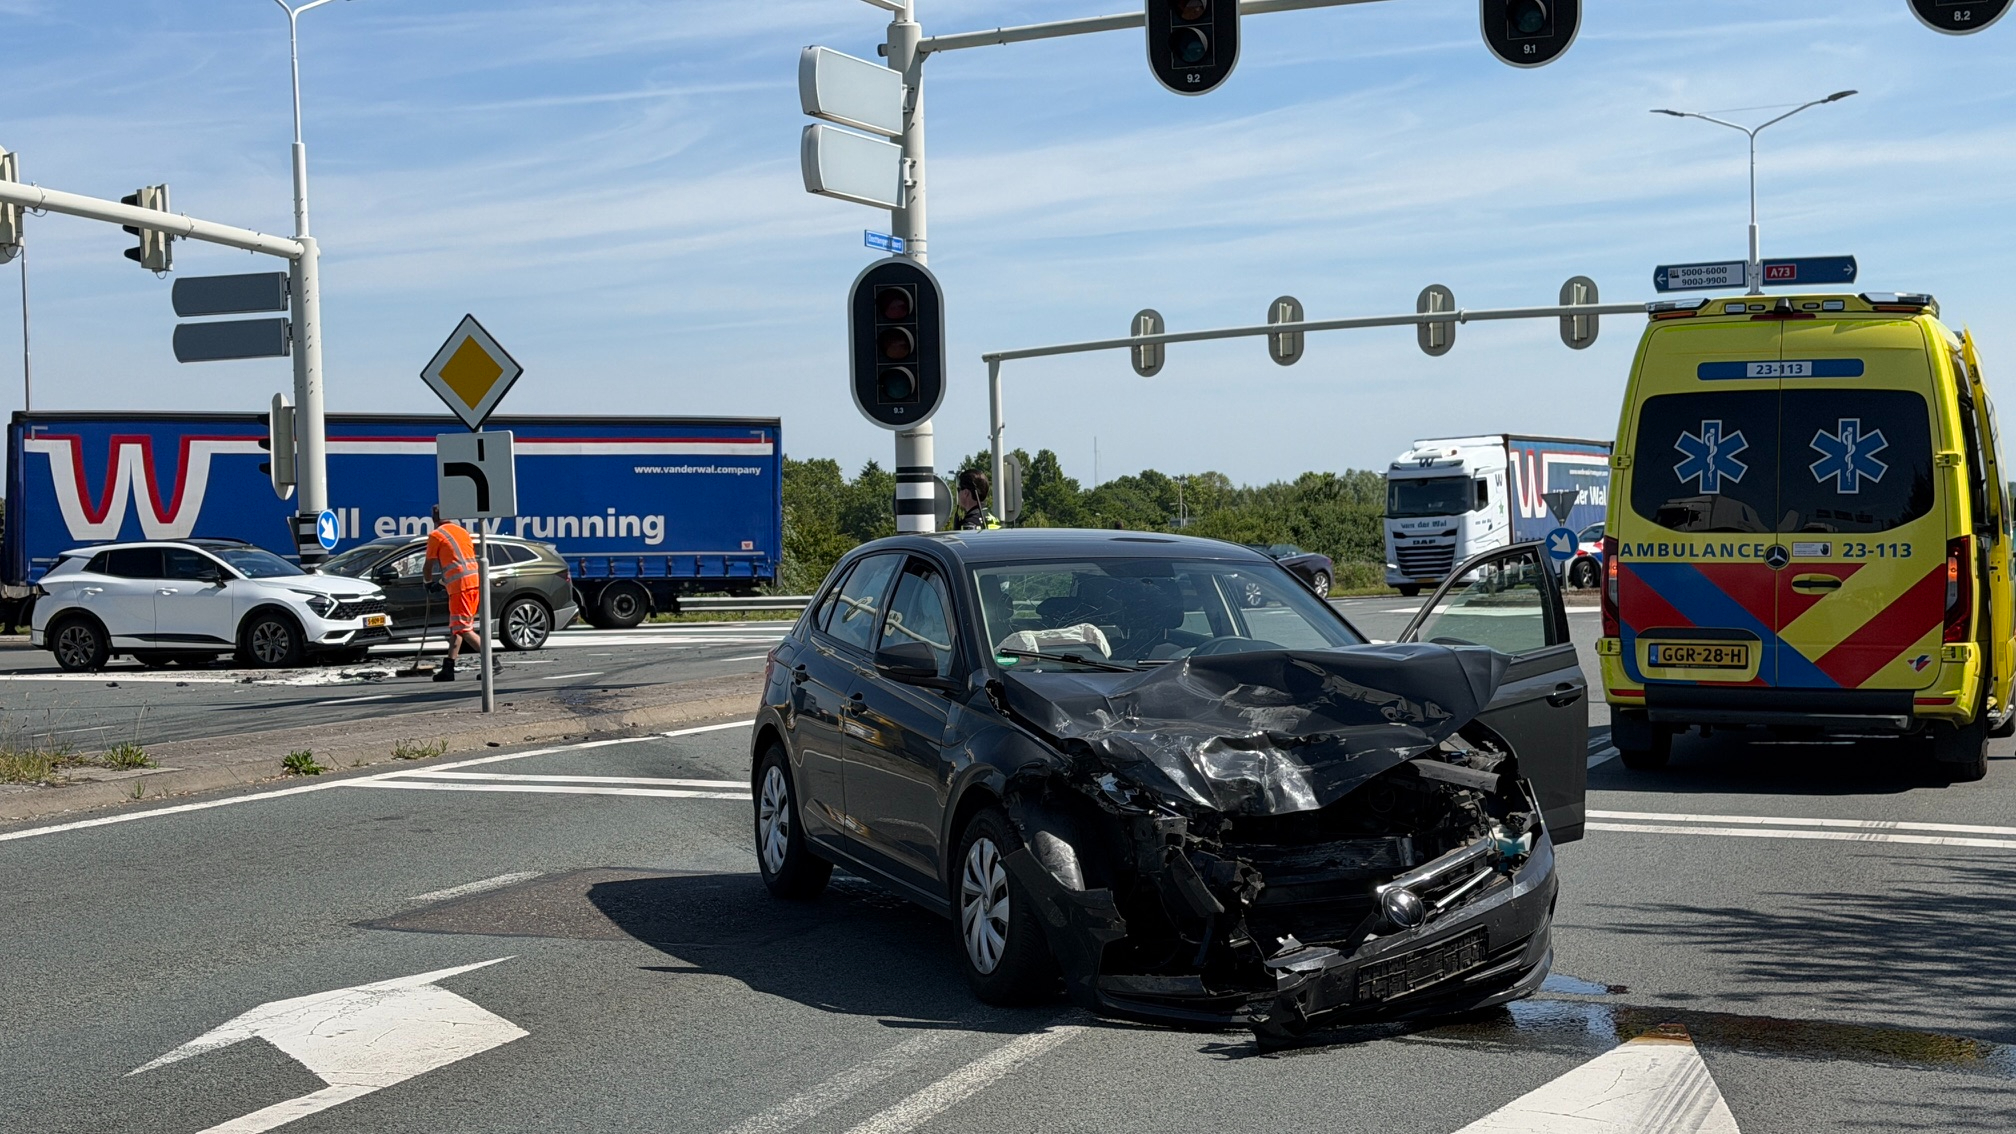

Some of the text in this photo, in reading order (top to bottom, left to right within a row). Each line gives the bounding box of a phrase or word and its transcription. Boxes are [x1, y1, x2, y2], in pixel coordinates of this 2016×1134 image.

[1954, 10, 1971, 21] 8.2
[1523, 44, 1536, 54] 9.1
[1186, 73, 1201, 83] 9.2
[1681, 266, 1728, 276] 5000-6000
[1770, 268, 1791, 278] A73
[1681, 276, 1728, 286] 9000-9900
[1756, 363, 1803, 375] 23-113
[893, 406, 904, 414] 9.3
[634, 465, 761, 476] www.vanderwal.company
[374, 515, 502, 539] emty
[515, 508, 665, 545] running
[1619, 542, 1765, 558] AMBULANCE
[1842, 542, 1912, 558] 23-113
[1662, 647, 1742, 663] GGR-28-H
